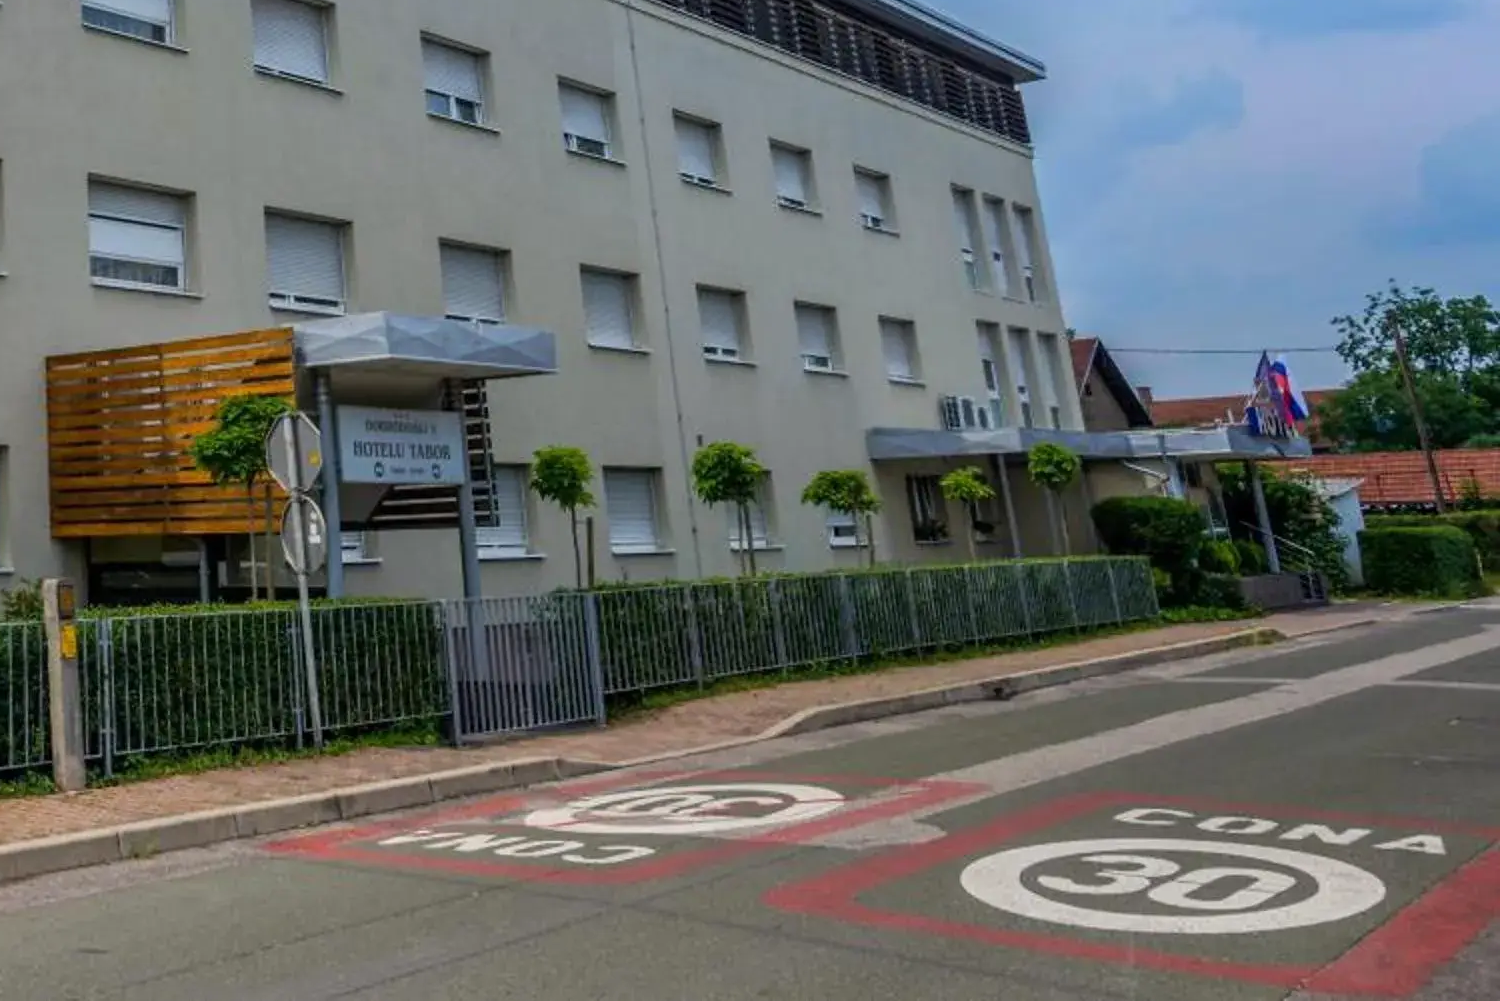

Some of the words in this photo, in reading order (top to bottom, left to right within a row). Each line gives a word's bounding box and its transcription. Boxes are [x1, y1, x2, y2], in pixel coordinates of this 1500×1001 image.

[353, 439, 405, 459] HOTELU
[409, 442, 451, 460] TABOR
[377, 830, 656, 864] CONA
[1113, 808, 1448, 856] CONA
[1035, 854, 1297, 910] 30
